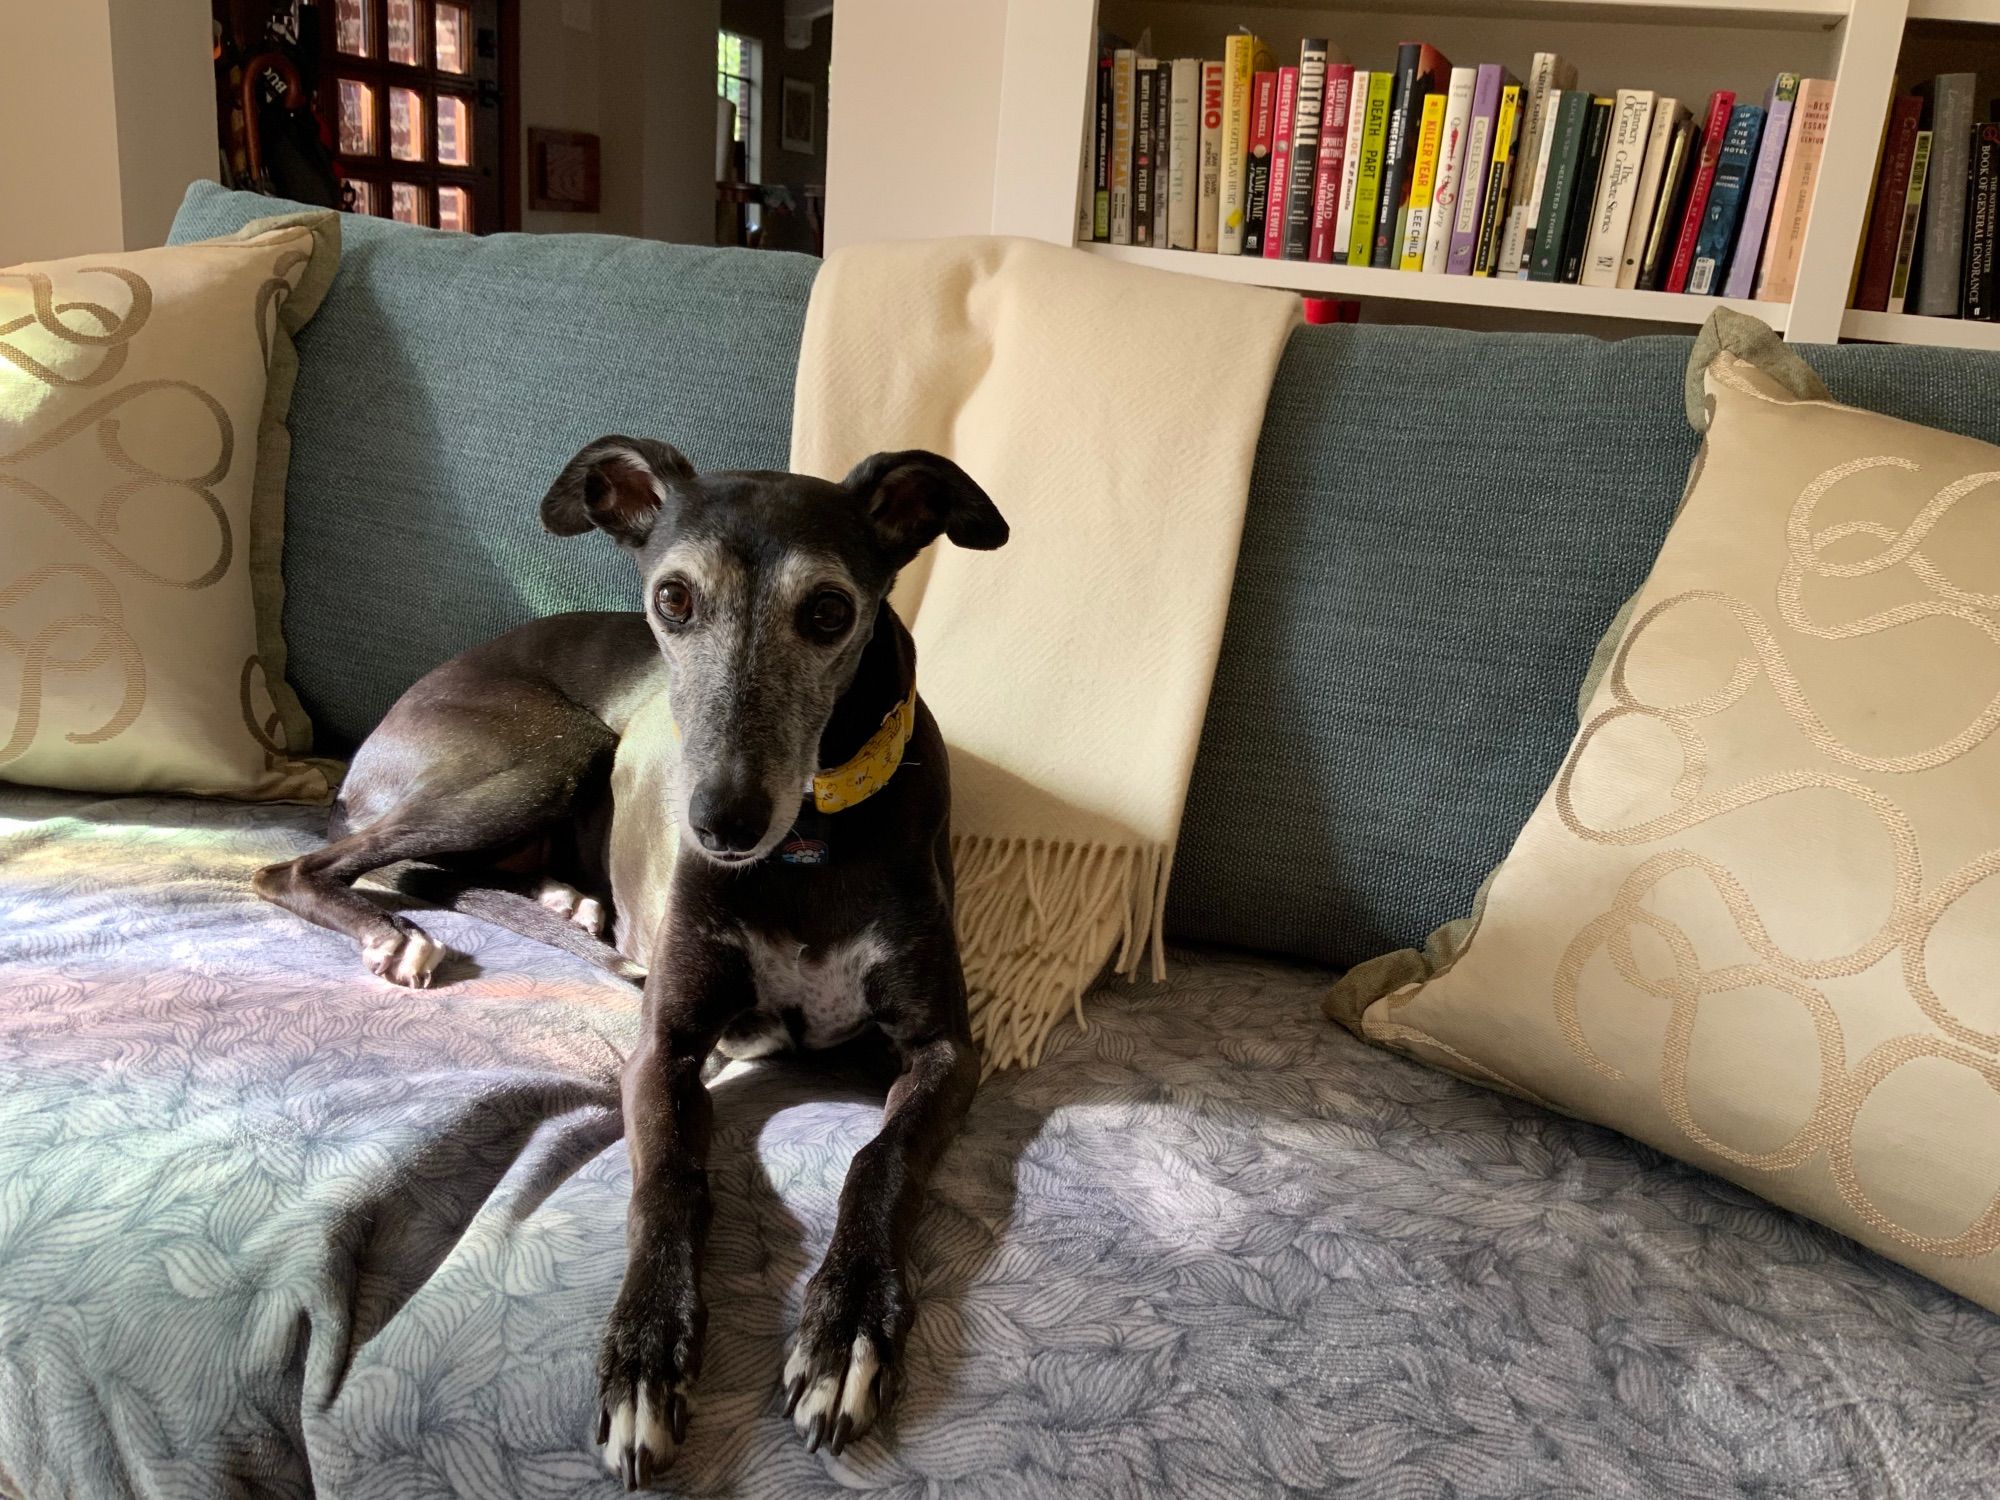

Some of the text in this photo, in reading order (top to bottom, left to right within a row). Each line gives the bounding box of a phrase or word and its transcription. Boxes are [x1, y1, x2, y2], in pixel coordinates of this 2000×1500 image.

[1160, 98, 1166, 106] OF
[1205, 67, 1223, 129] LIMO
[1295, 51, 1326, 147] FOOTBALL
[1325, 80, 1337, 126] THEY HAD
[1333, 79, 1347, 127] EVERYTHING
[1353, 75, 1365, 132] SHOELESS
[1530, 62, 1548, 135] UNHOLY GHOST
[1568, 97, 1578, 123] ALICE
[1806, 112, 1829, 120] AMERICA
[1813, 101, 1830, 111] BES
[1232, 110, 1241, 126] YOU
[1258, 109, 1268, 138] ANGELL
[1369, 100, 1384, 136] DEATH
[1628, 102, 1647, 145] Flannery
[1712, 111, 1724, 137] SPEAK
[1803, 121, 1826, 130] ESSAY
[1138, 75, 1150, 212] NORTH DALLAS FORTY PETER GENT
[1230, 128, 1240, 156] GOTTA
[1351, 136, 1359, 155] JOE
[1386, 108, 1401, 165] VENGEANCE
[1418, 120, 1438, 186] KILLER YEAR
[1724, 146, 1748, 155] HOTEL
[1801, 136, 1824, 144] CENTUR
[1228, 157, 1239, 178] PLAY
[1269, 73, 1293, 238] MONEYBALL MICHAEL LEWIS
[1362, 150, 1378, 179] PART
[1620, 164, 1634, 183] The
[1226, 180, 1237, 205] HURT
[1252, 166, 1267, 220] GAME TIME
[1460, 120, 1485, 230] CARELESS WEEDS
[1491, 163, 1502, 201] SPEAKING
[1552, 164, 1566, 209] SELECTED
[1602, 150, 1628, 234] Complete Stories
[1315, 173, 1328, 228] HALBERSTAM
[1324, 183, 1335, 219] DAVID
[1381, 206, 1389, 224] CHILD
[1986, 193, 1996, 238] NOTICEABLY
[1408, 210, 1423, 258] LEE CHILD
[1544, 212, 1556, 249] STORIES
[1969, 145, 1991, 304] BOOK OF GENERAL IGNORANCE
[1479, 245, 1487, 269] ANGEL
[1984, 239, 1992, 273] STOUTER
